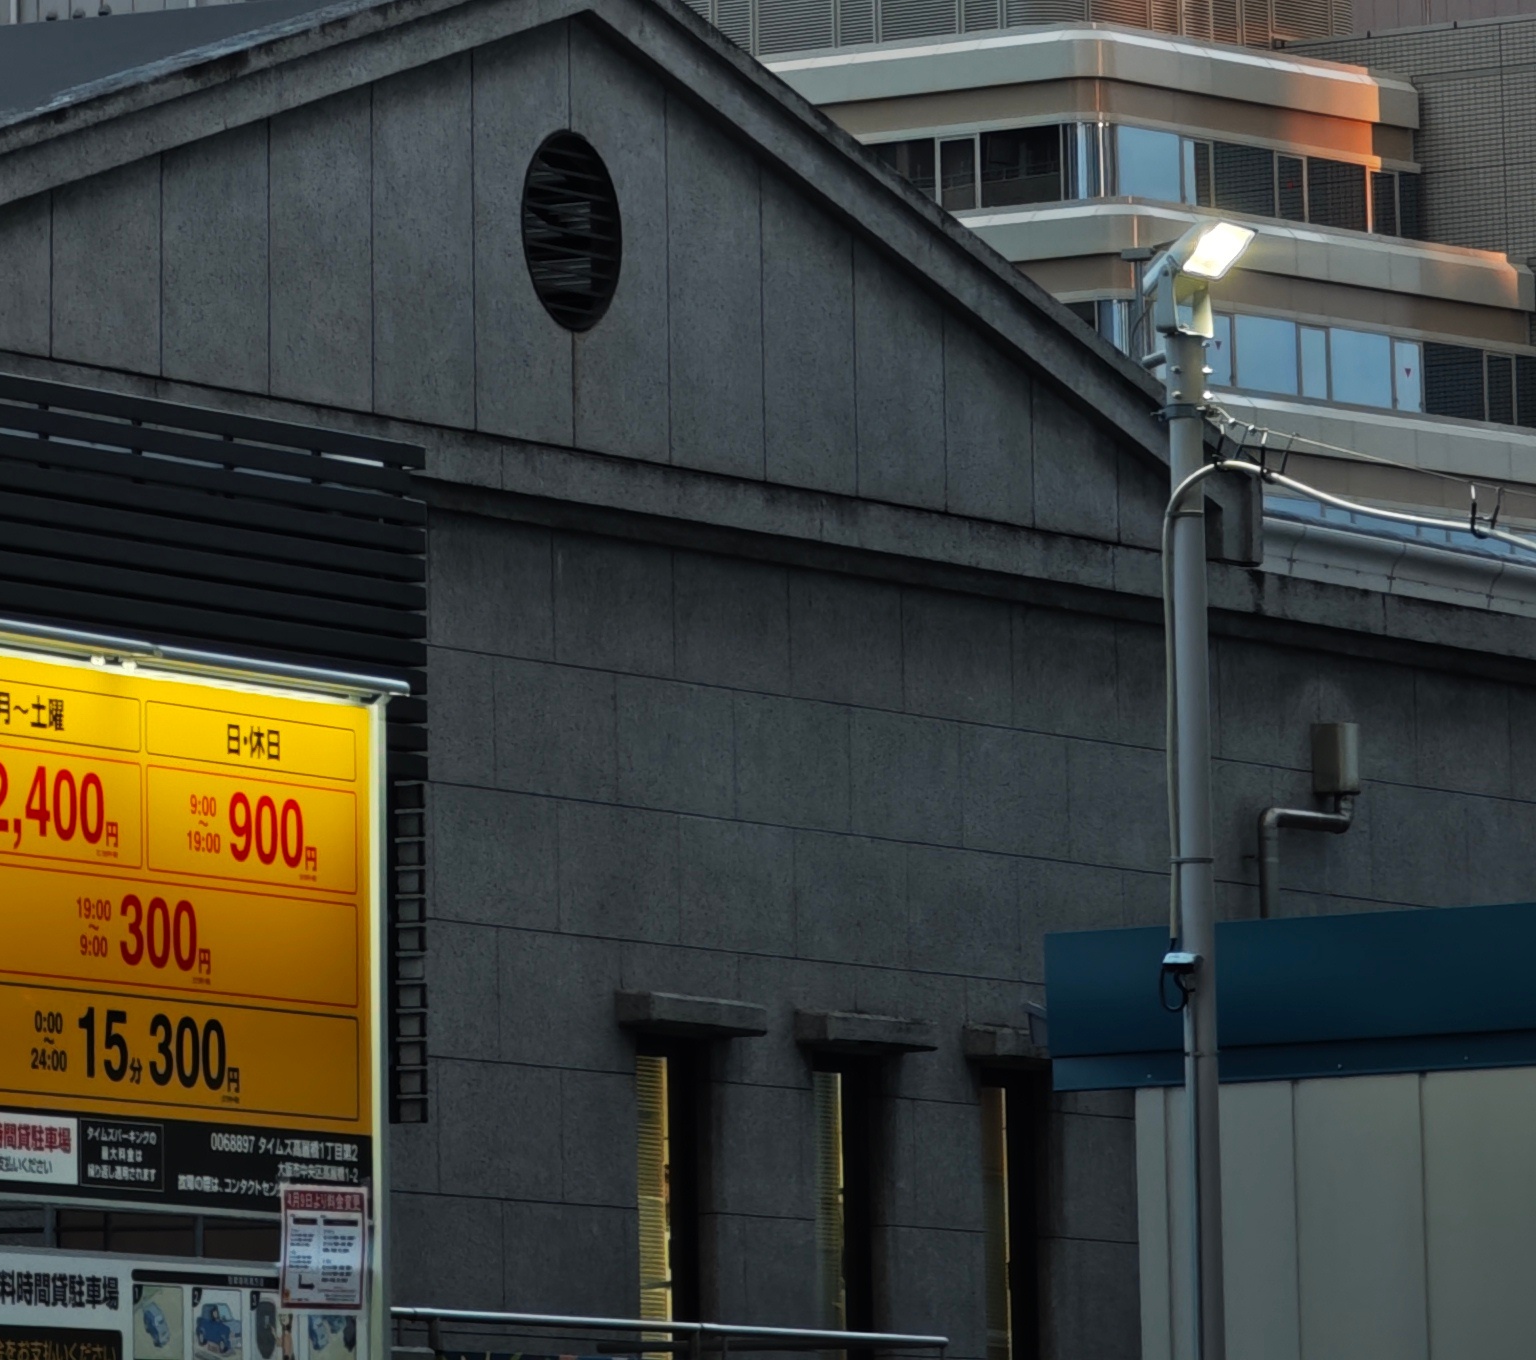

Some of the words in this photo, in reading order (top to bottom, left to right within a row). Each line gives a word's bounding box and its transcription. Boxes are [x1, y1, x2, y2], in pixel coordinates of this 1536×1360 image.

[190, 794, 217, 817] 9:00
[187, 830, 221, 854] 19:00
[76, 897, 112, 921] 19:00
[80, 934, 108, 958] 9:00
[34, 1010, 63, 1034] 0:00
[30, 1047, 68, 1073] 24:00
